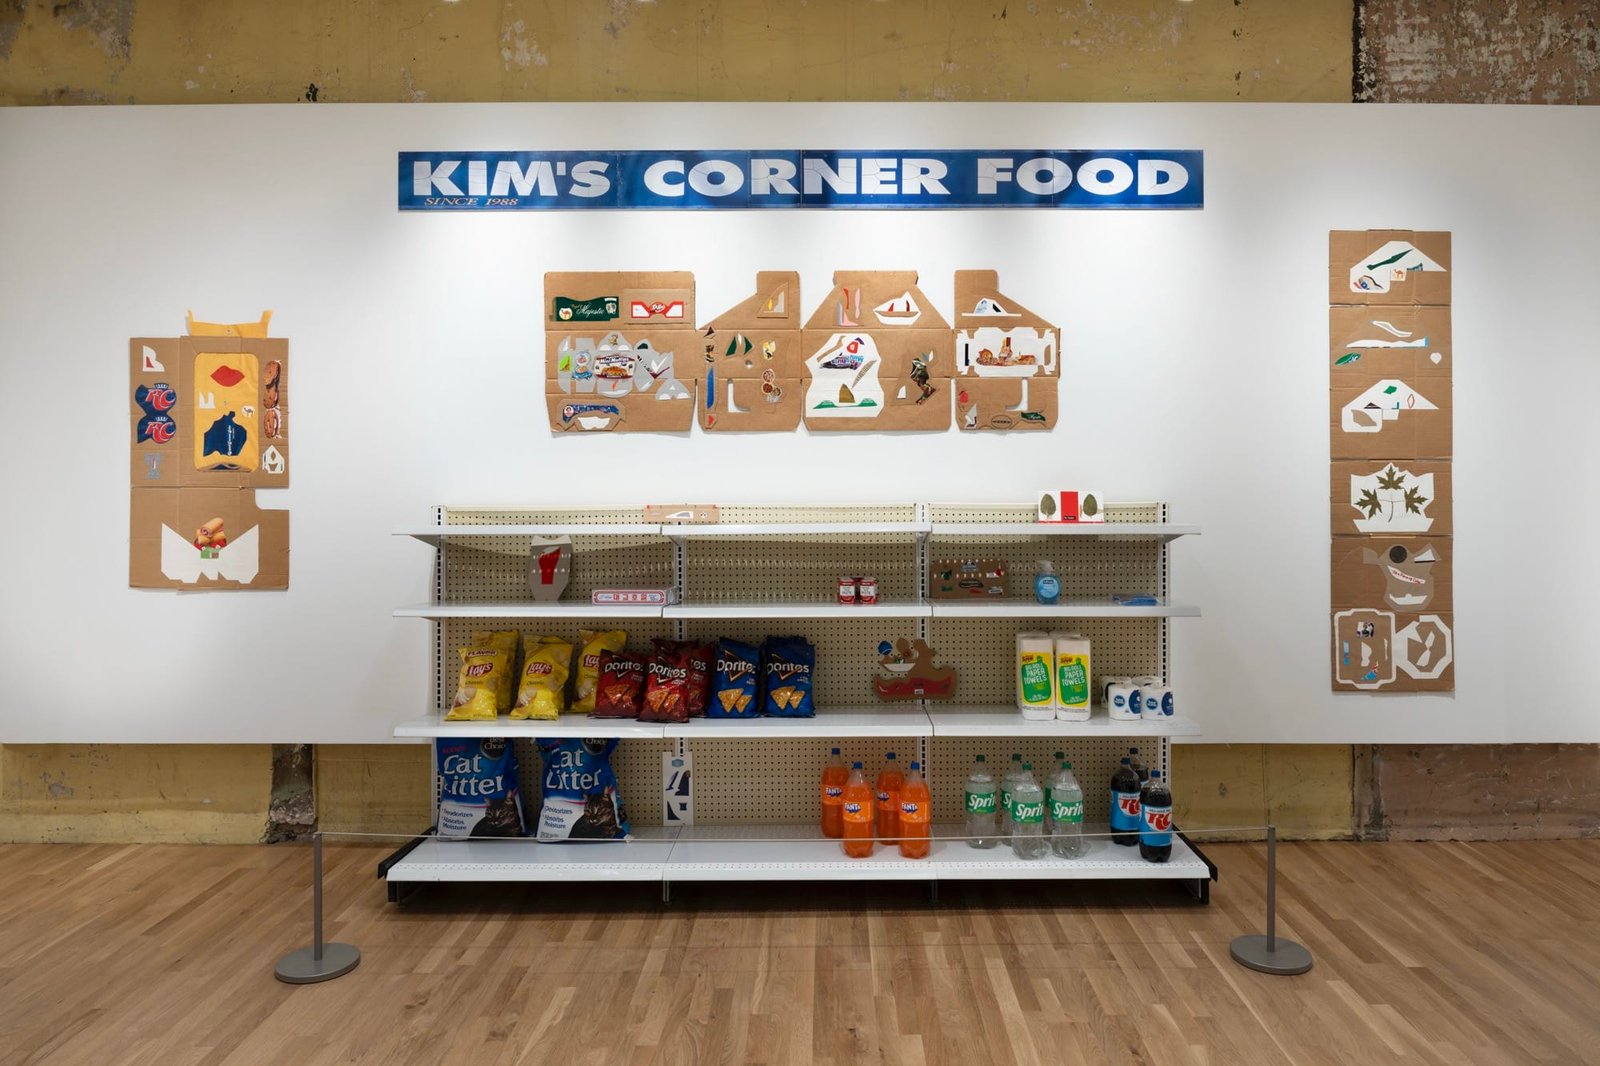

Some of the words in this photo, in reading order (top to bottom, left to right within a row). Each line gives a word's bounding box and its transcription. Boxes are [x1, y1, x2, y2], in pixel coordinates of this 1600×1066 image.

[413, 160, 610, 197] KIM'S
[643, 158, 951, 197] CORNER
[977, 157, 1189, 196] FOOD
[424, 197, 478, 206] SINCE
[485, 198, 518, 206] 1988
[145, 389, 177, 411] RC
[145, 421, 177, 443] RC
[1024, 676, 1048, 685] TOWELS
[1026, 668, 1046, 678] PAPER
[1062, 677, 1086, 687] TOWELS
[1064, 669, 1084, 680] PAPER
[444, 753, 482, 774] Cat
[546, 768, 602, 790] Litter
[1146, 812, 1171, 831] RC
